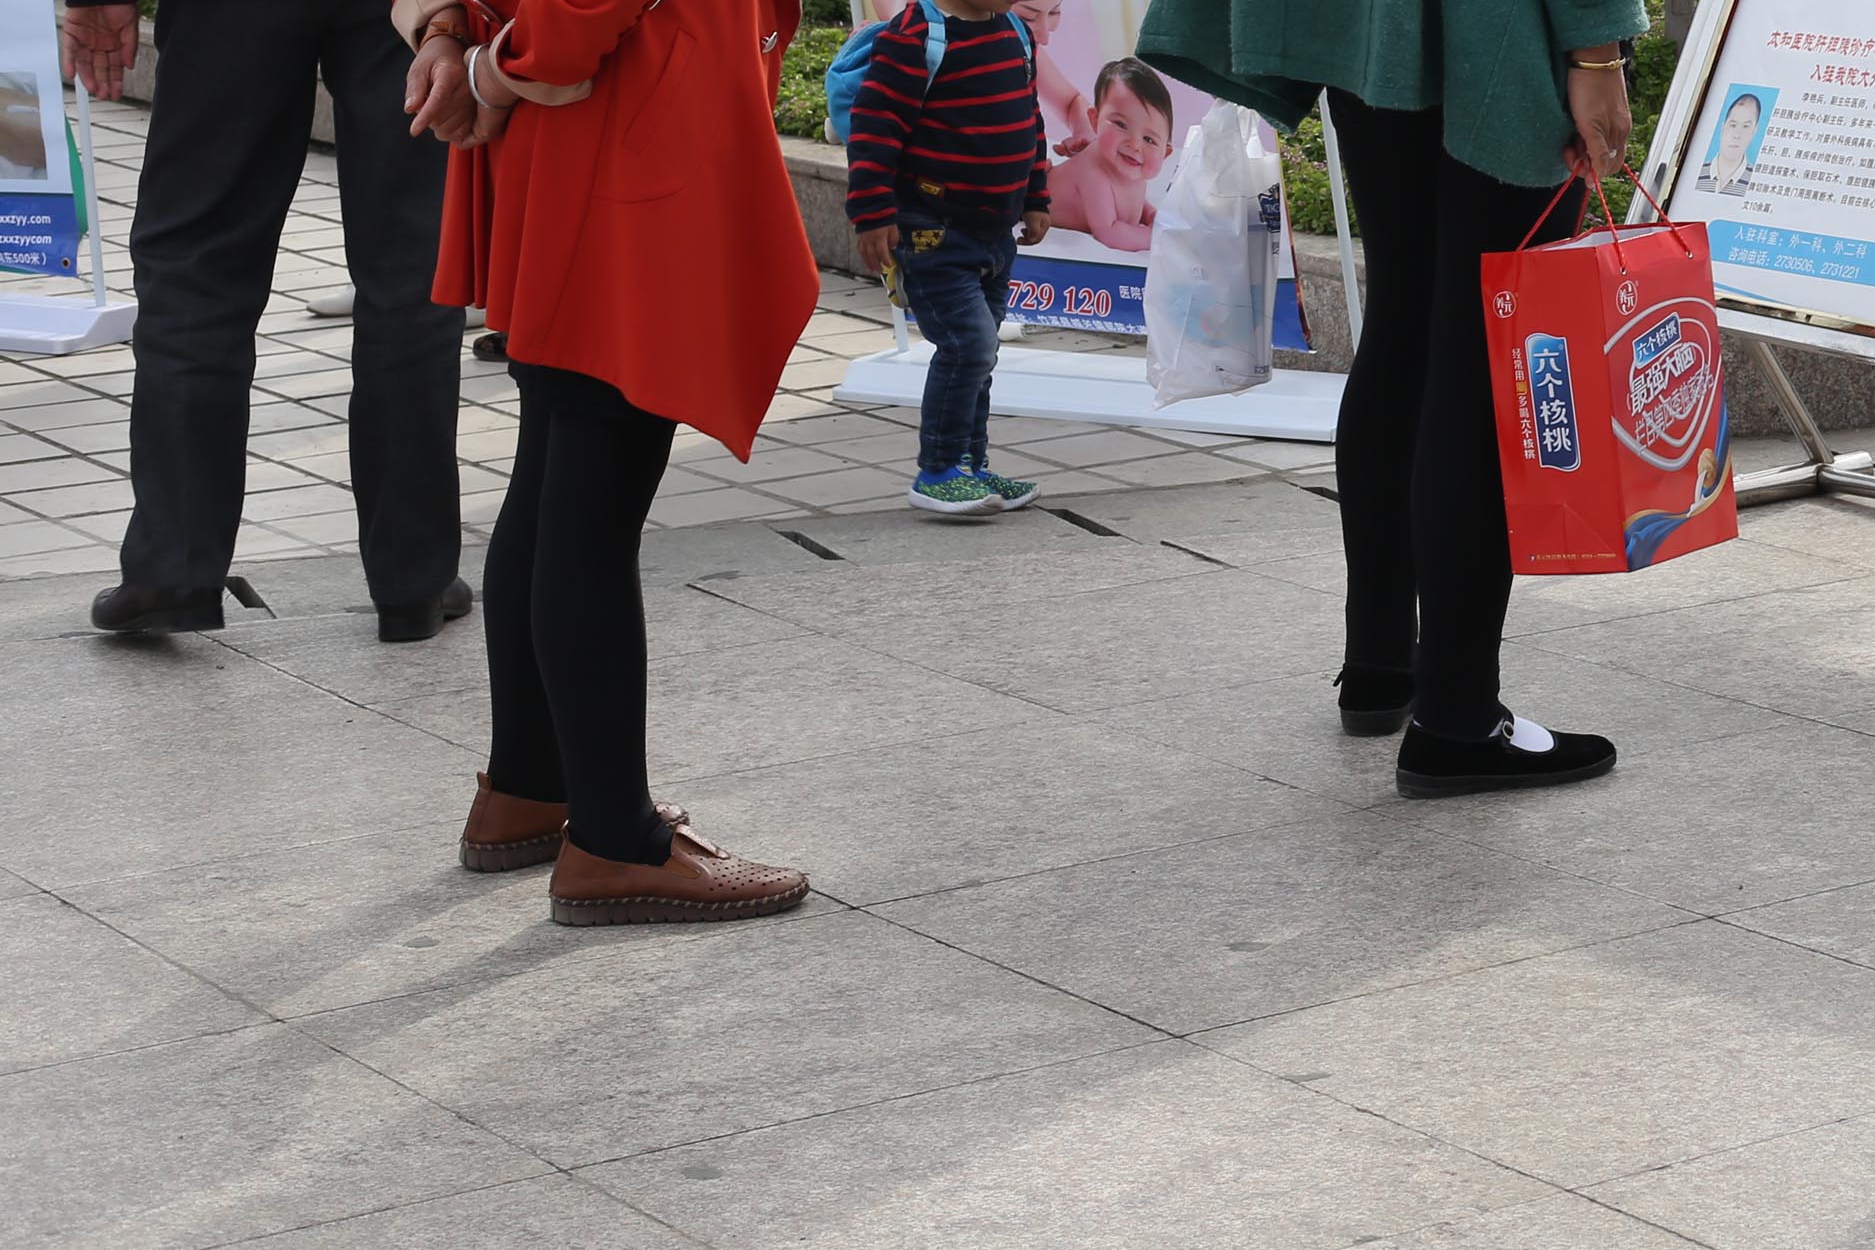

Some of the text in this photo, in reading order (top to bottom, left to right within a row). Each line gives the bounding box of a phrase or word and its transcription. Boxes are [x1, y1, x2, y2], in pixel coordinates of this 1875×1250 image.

[1063, 286, 1111, 318] 120
[1119, 285, 1144, 300] 医院
[1636, 318, 1678, 362] 六个核桃
[1533, 348, 1573, 453] 六个核桃
[1631, 345, 1695, 417] 最强大脑
